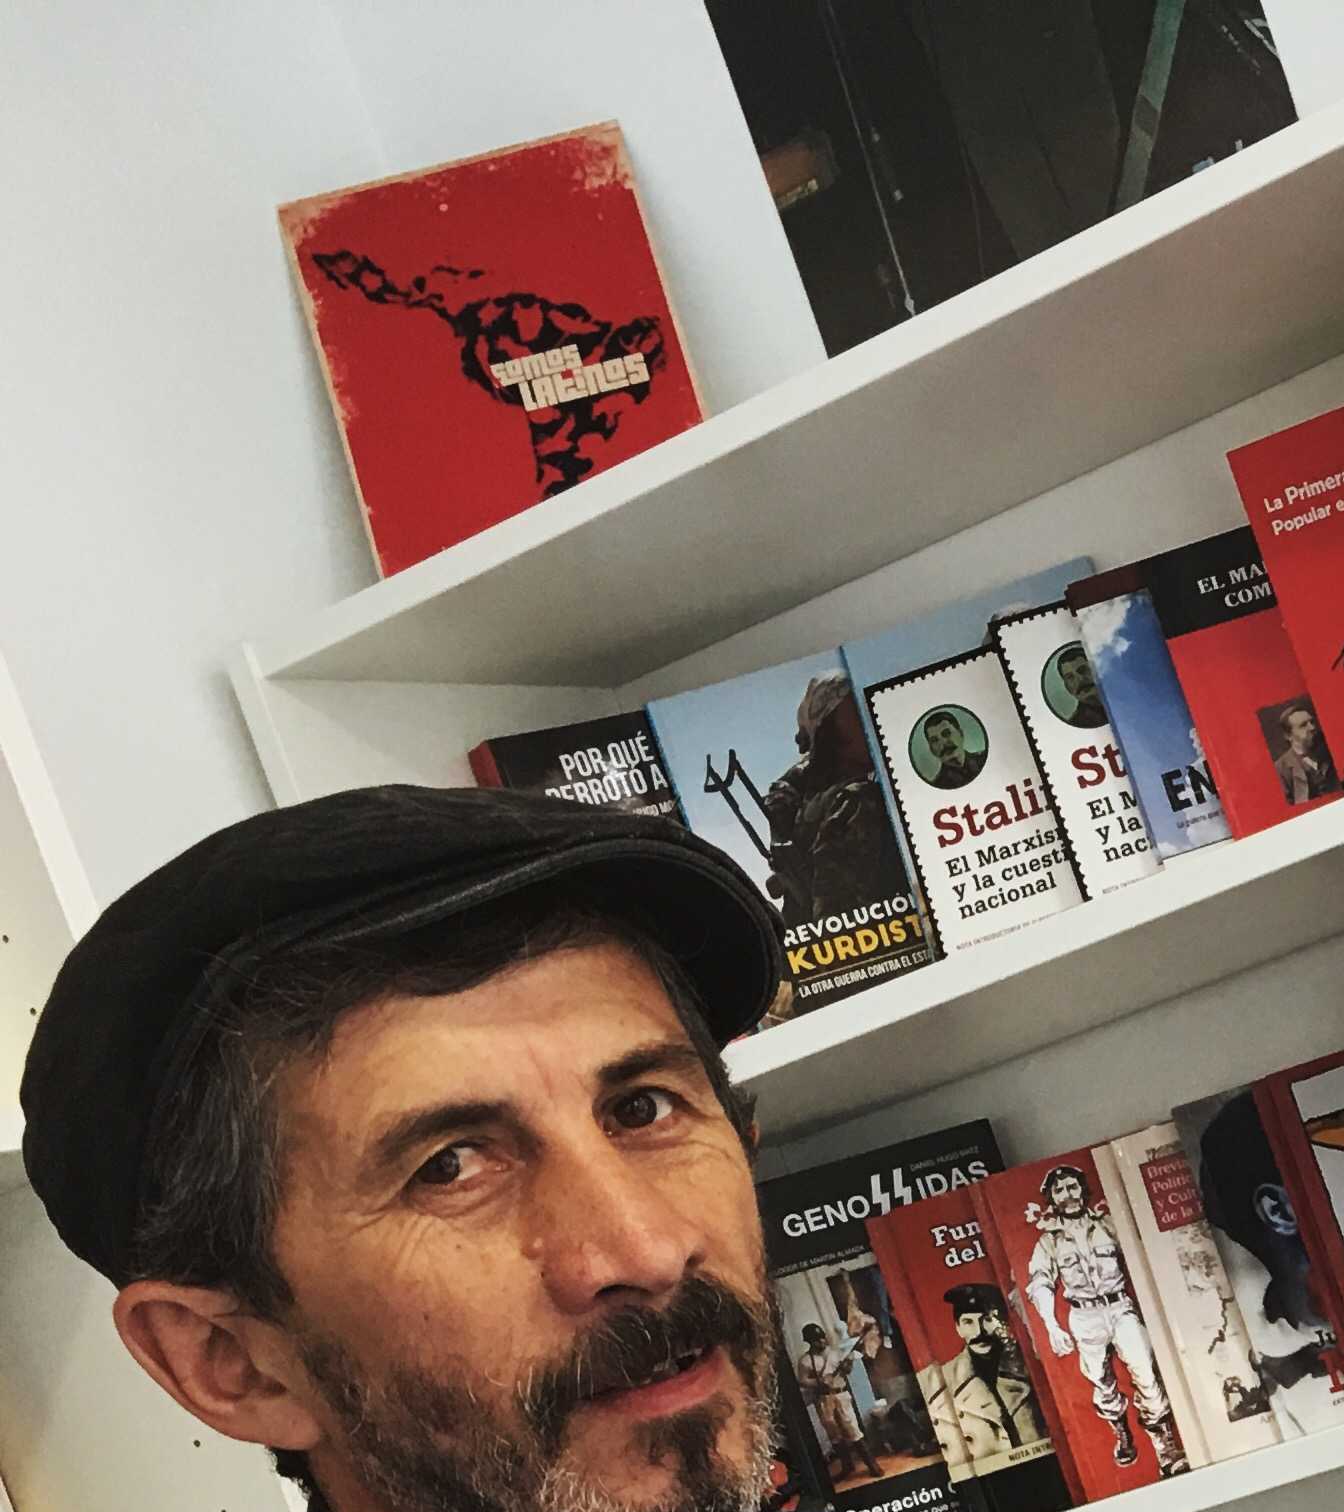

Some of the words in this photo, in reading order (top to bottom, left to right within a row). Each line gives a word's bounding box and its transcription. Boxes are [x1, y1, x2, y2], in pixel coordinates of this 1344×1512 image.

[1263, 497, 1283, 514] La
[1271, 502, 1331, 536] Popular
[1197, 574, 1226, 594] EL
[558, 747, 607, 780] POR
[607, 731, 655, 769] QUÉ
[650, 764, 669, 790] A
[1086, 796, 1115, 820] El
[1095, 826, 1110, 845] y
[1117, 816, 1143, 834] la
[945, 856, 970, 877] El
[953, 883, 966, 902] y
[973, 870, 996, 891] la
[957, 871, 1058, 919] nacional
[1161, 1209, 1178, 1224] de
[931, 1221, 982, 1246] Fun
[944, 1240, 985, 1267] del
